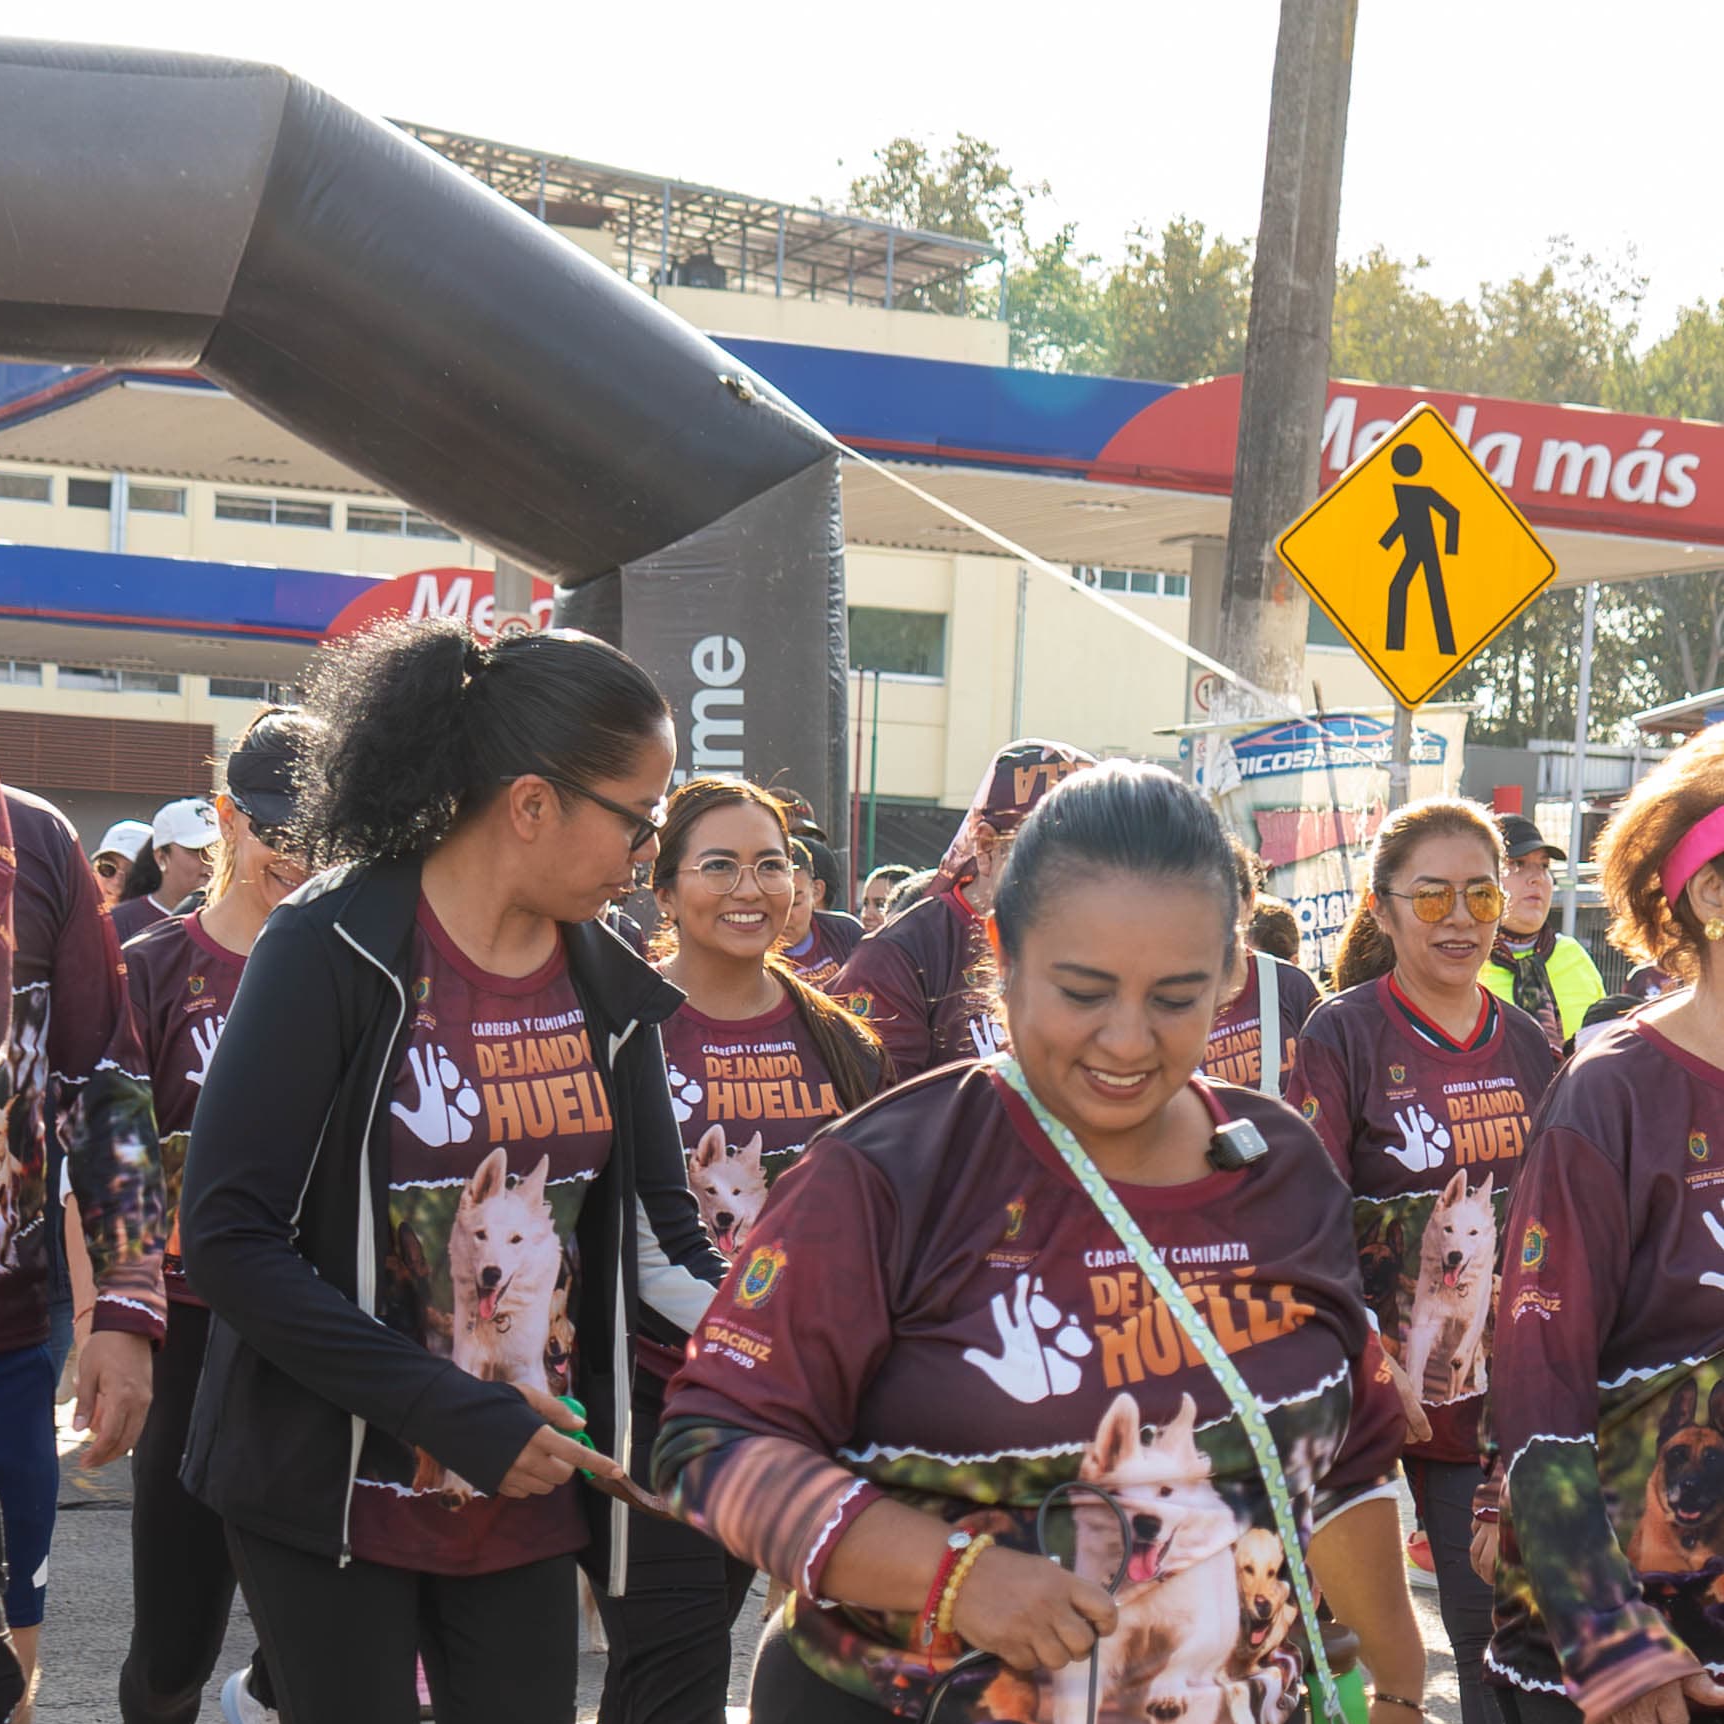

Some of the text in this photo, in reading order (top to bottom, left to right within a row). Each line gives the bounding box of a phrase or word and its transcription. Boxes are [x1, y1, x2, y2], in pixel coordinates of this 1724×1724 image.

[1533, 430, 1700, 508] más
[472, 1021, 521, 1037] CARRERA
[523, 1018, 532, 1032] Y
[702, 1044, 743, 1056] CARRERA
[705, 1054, 803, 1079] DEJANDO
[707, 1080, 844, 1121] HUELLA
[1446, 1090, 1525, 1121] DEJANDO
[1172, 1243, 1250, 1264] CAMINATA
